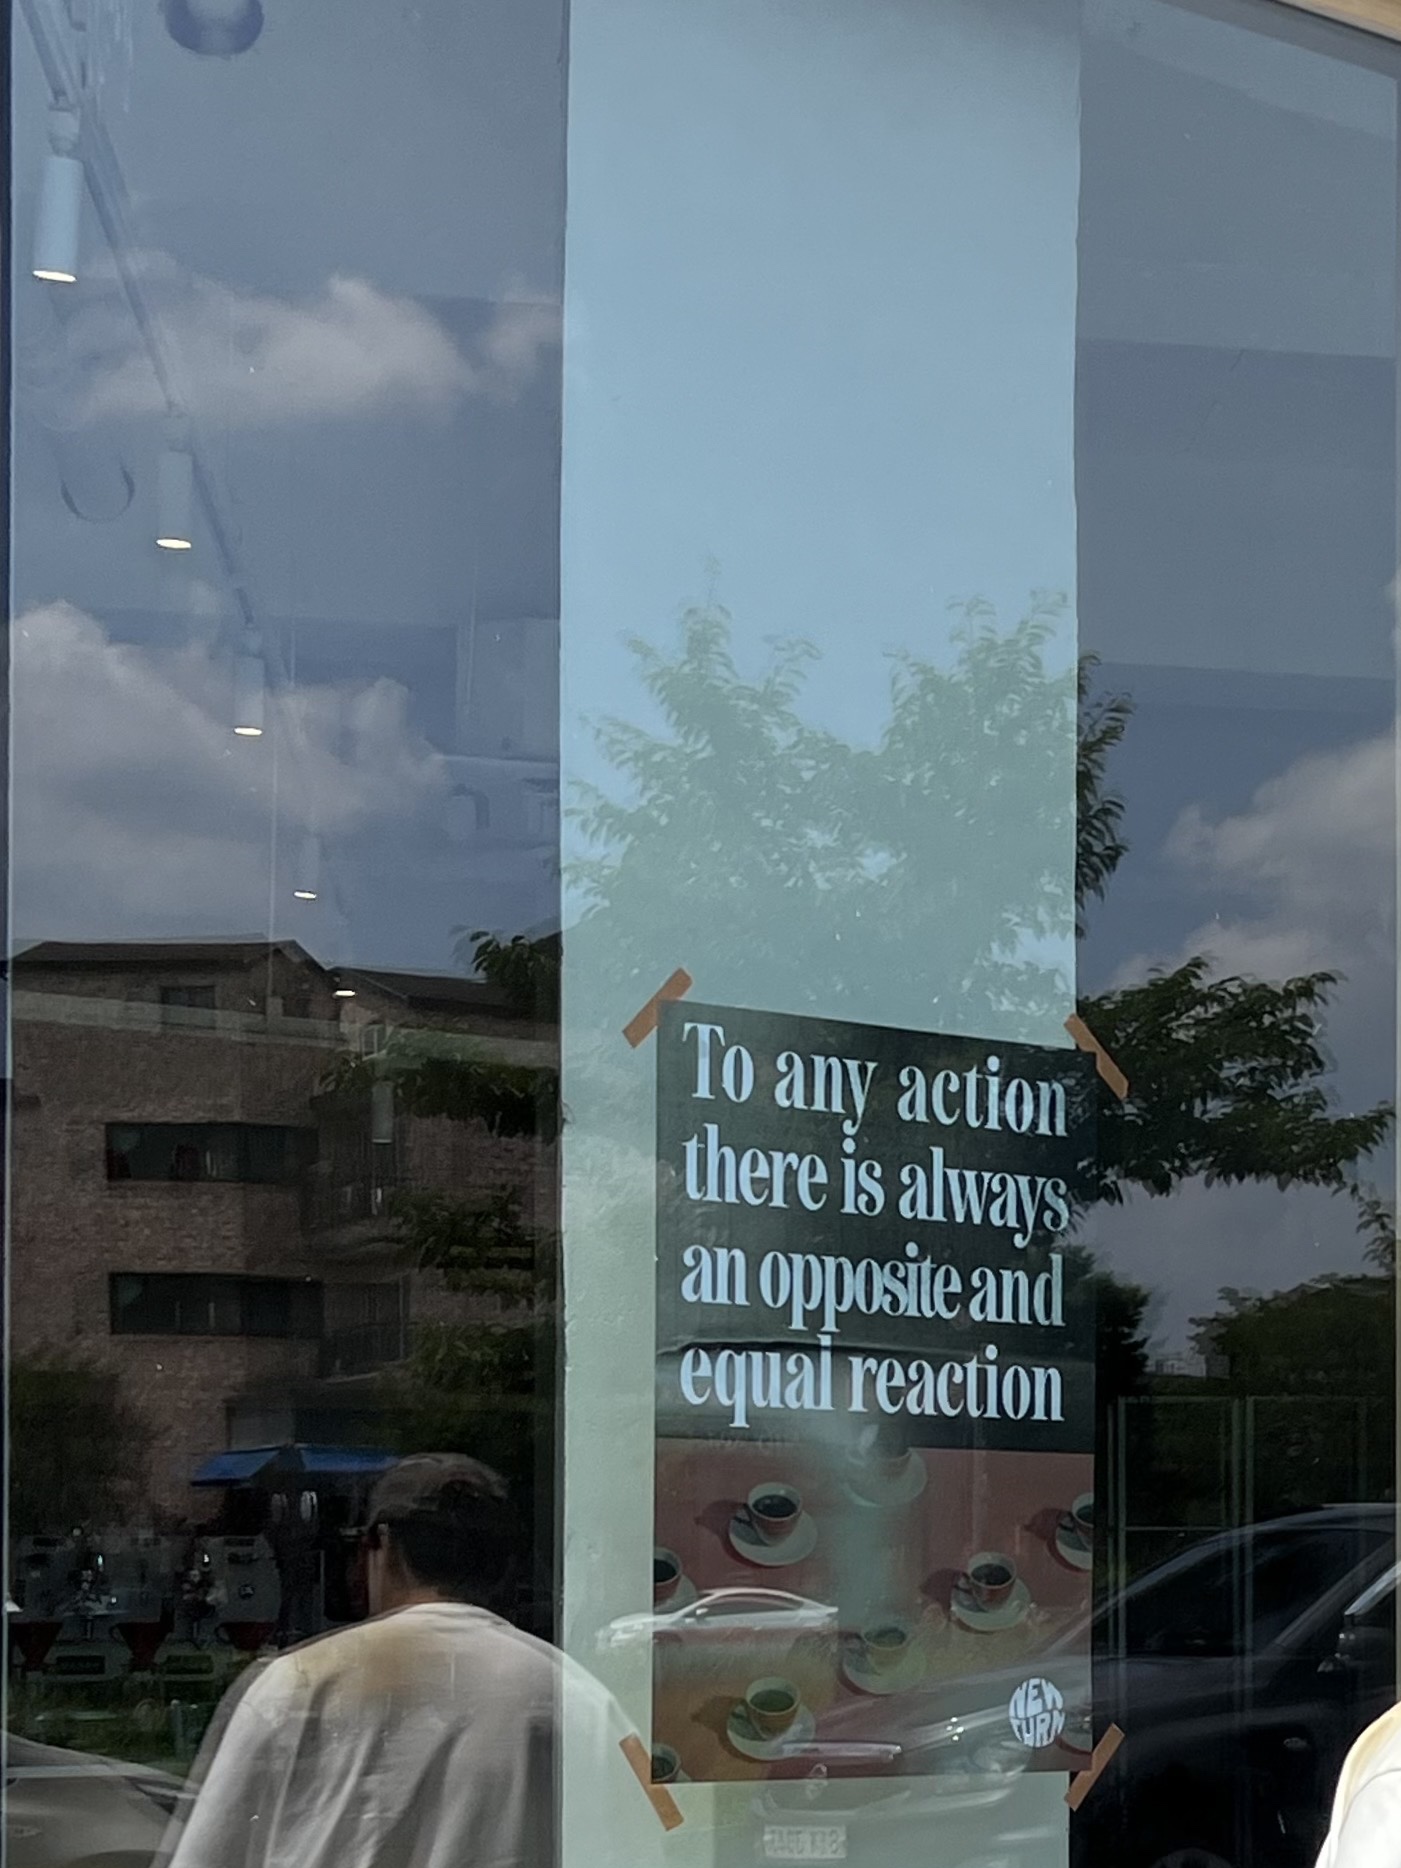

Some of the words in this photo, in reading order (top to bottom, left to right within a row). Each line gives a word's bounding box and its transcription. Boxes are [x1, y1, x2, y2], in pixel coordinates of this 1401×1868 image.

[682, 1022, 754, 1103] To
[774, 1051, 878, 1136] any
[897, 1055, 1067, 1136] action
[681, 1122, 828, 1211] there
[840, 1137, 885, 1216] is
[898, 1146, 1071, 1248] always
[680, 1244, 750, 1306] an
[759, 1242, 962, 1333] opposite
[969, 1253, 1065, 1326] and
[679, 1333, 836, 1428] equal
[847, 1344, 1064, 1421] reaction
[1009, 1678, 1064, 1718] NEW
[1010, 1709, 1066, 1748] TURN
